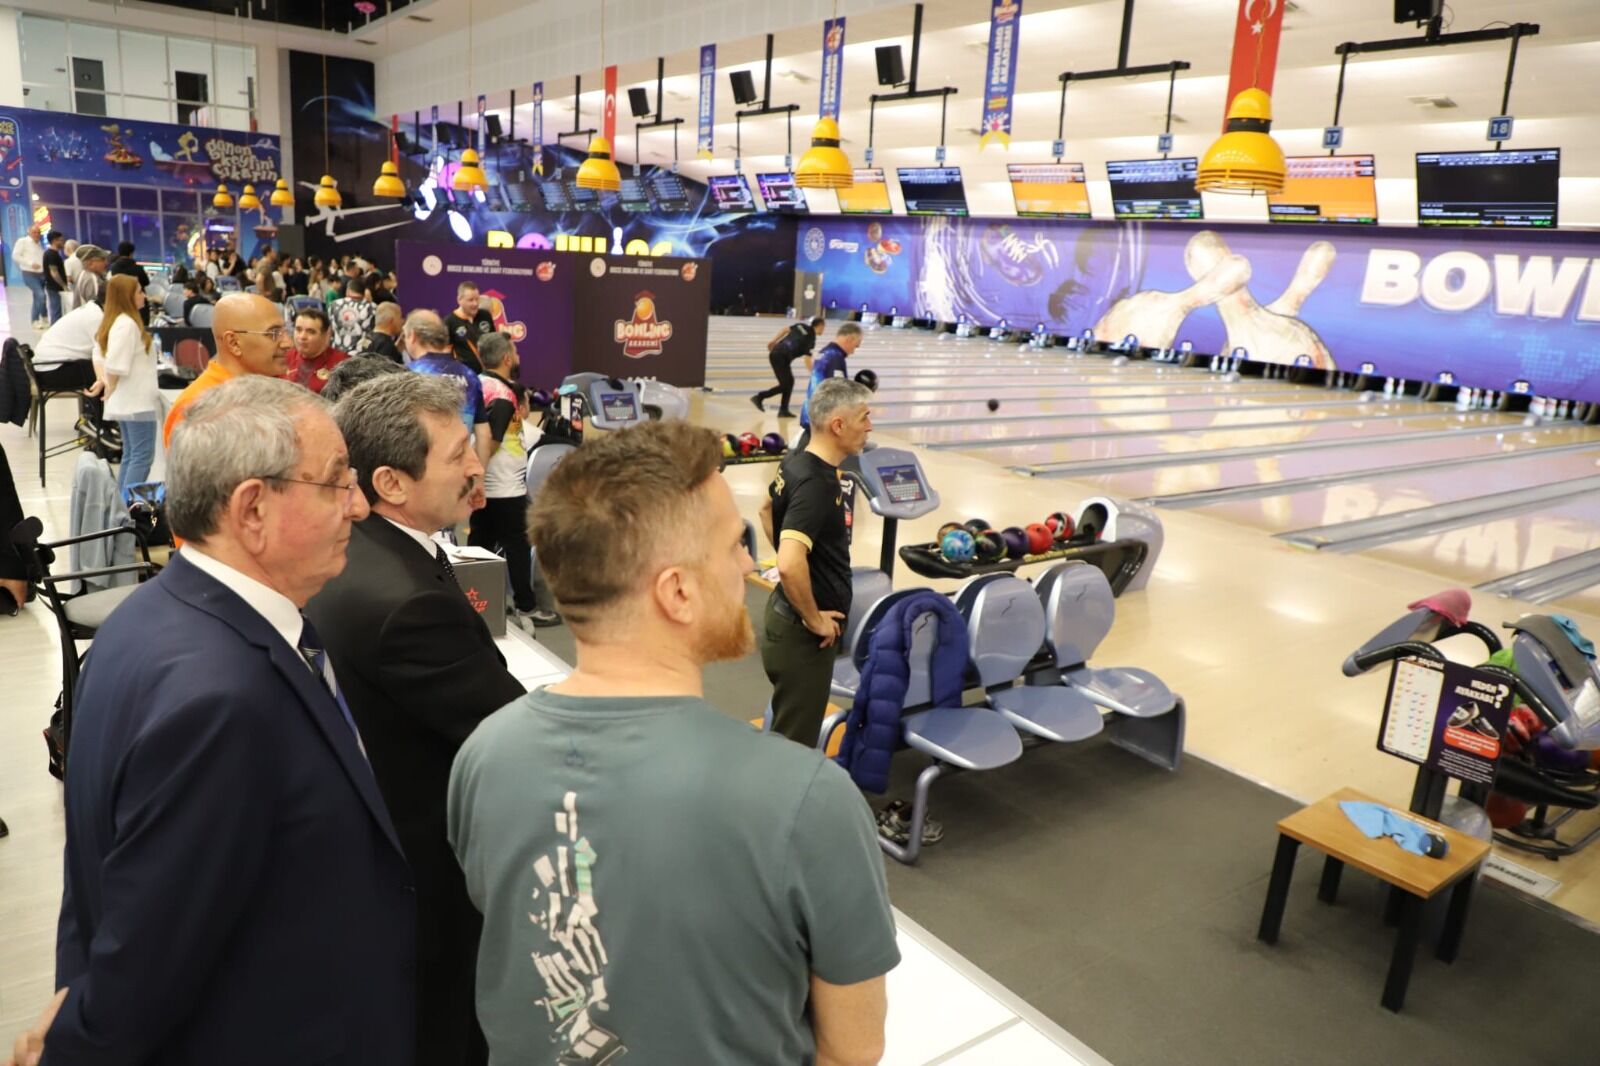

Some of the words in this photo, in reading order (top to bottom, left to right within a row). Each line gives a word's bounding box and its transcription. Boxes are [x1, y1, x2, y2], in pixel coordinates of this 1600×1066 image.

[1492, 122, 1509, 135] 18
[1326, 132, 1338, 143] 17
[616, 322, 671, 340] BOWLING
